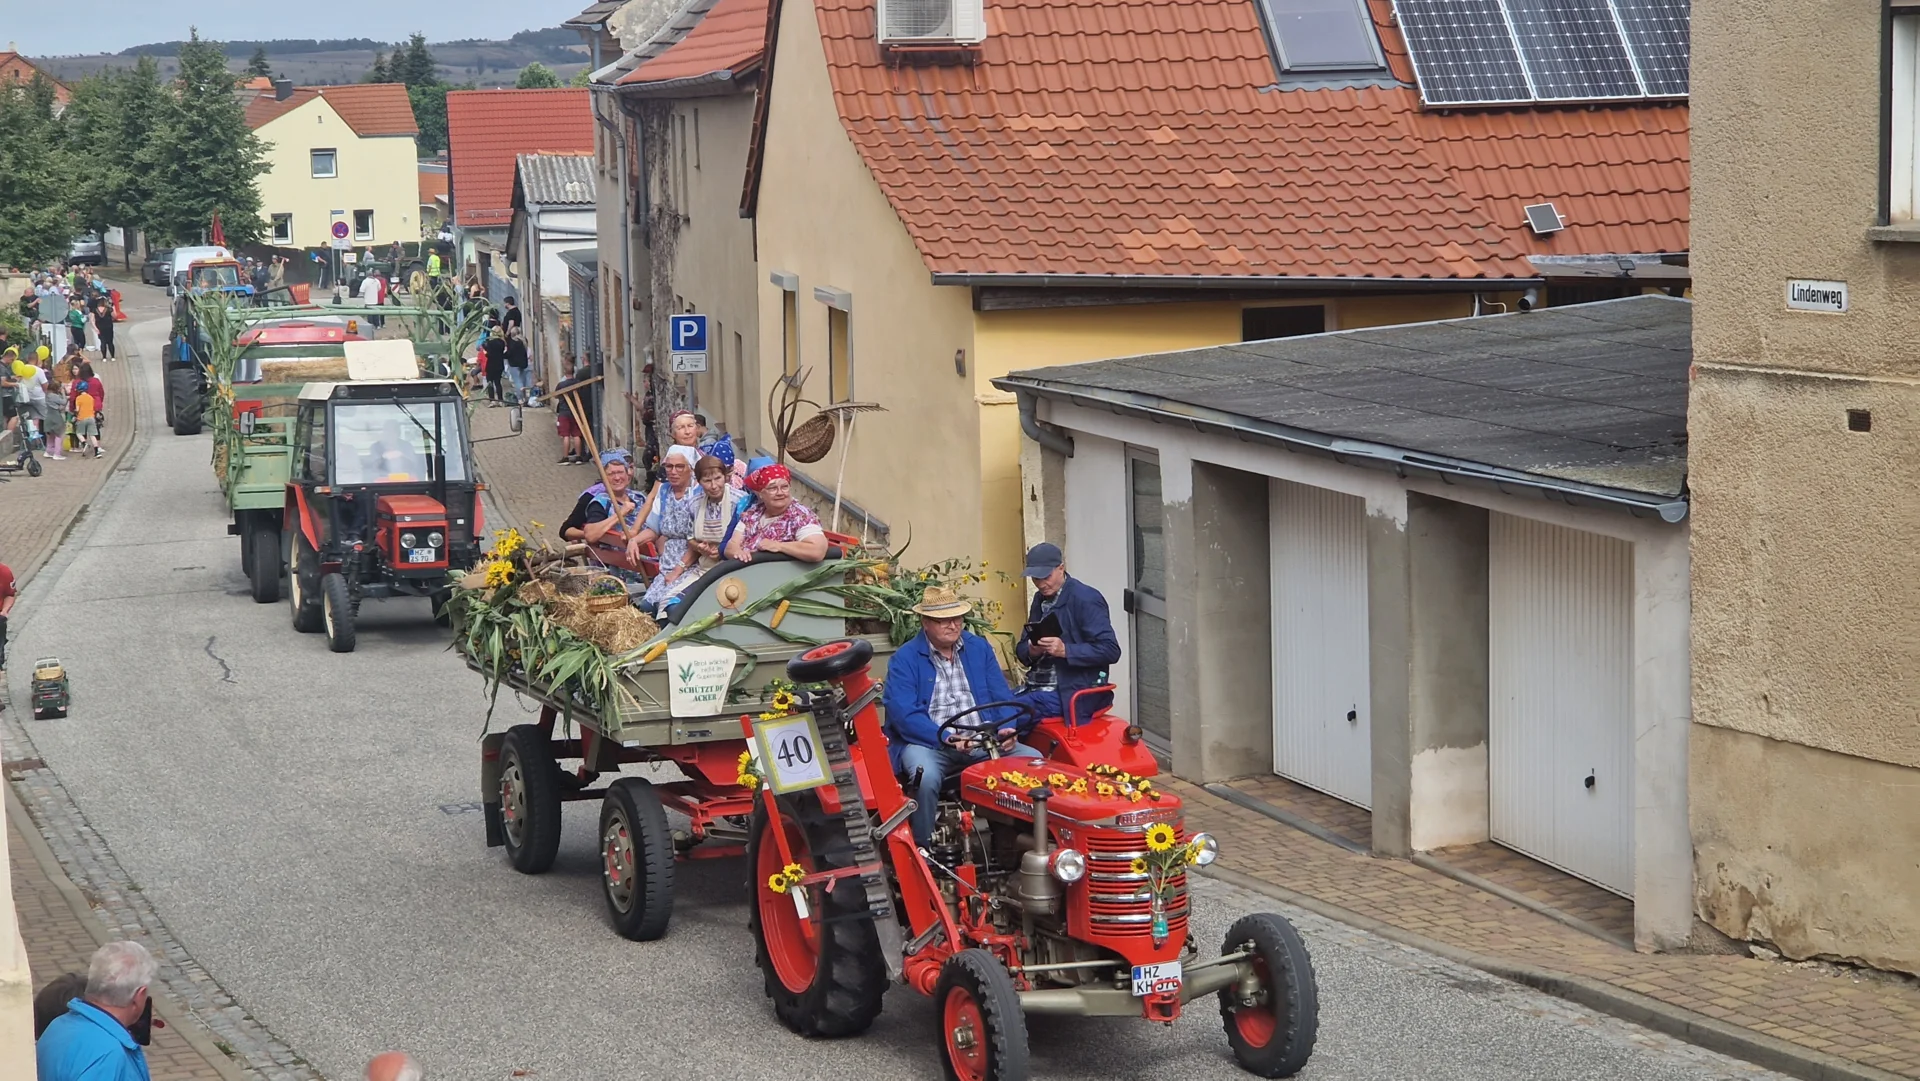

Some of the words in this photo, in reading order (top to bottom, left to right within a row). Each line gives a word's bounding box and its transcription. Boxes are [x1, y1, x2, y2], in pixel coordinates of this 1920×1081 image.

[1792, 283, 1843, 309] Lindenweg
[679, 320, 699, 347] P
[679, 685, 714, 694] SCHÜTZT
[715, 684, 725, 692] DE
[693, 693, 717, 702] ACKER
[777, 735, 813, 768] 40
[1143, 966, 1160, 979] HZ
[1136, 980, 1153, 993] KH
